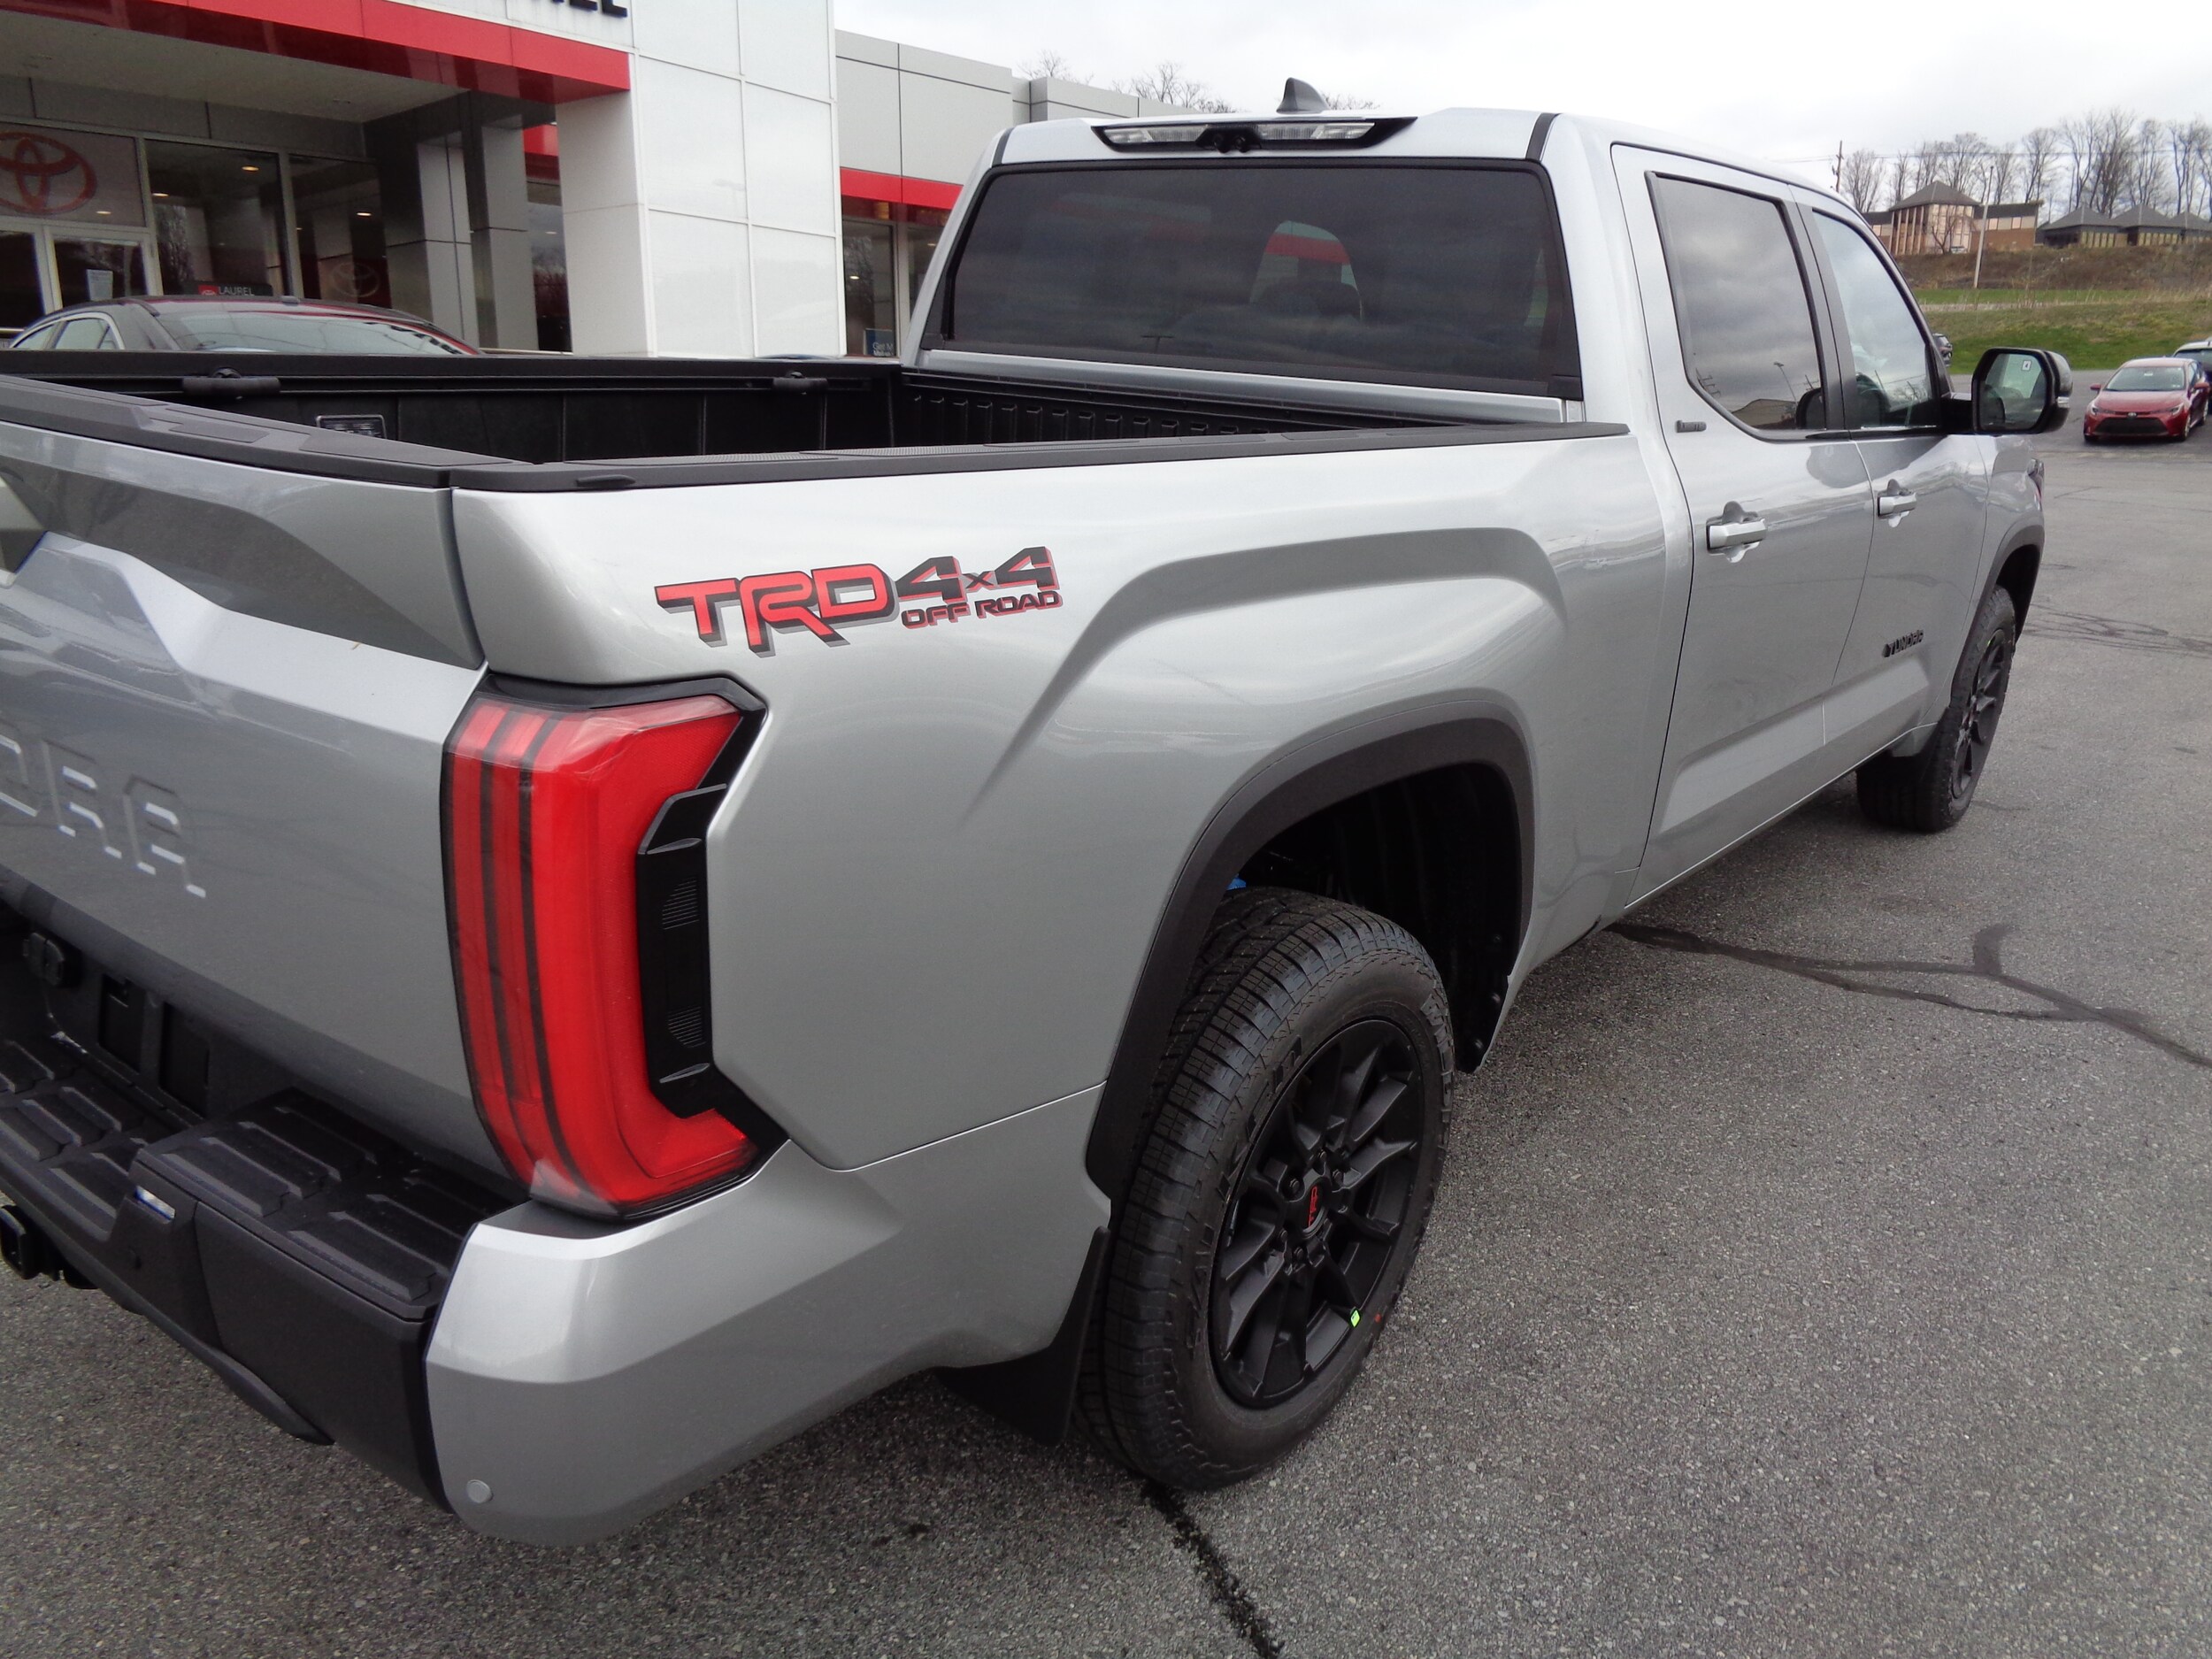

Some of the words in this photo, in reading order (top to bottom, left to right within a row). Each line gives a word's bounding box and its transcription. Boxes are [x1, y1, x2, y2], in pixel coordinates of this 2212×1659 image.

[219, 287, 255, 296] LAUREL
[654, 562, 900, 658] TRD
[901, 602, 972, 630] OFF
[973, 588, 1064, 619] ROAD
[1887, 629, 1924, 655] TUNDRA
